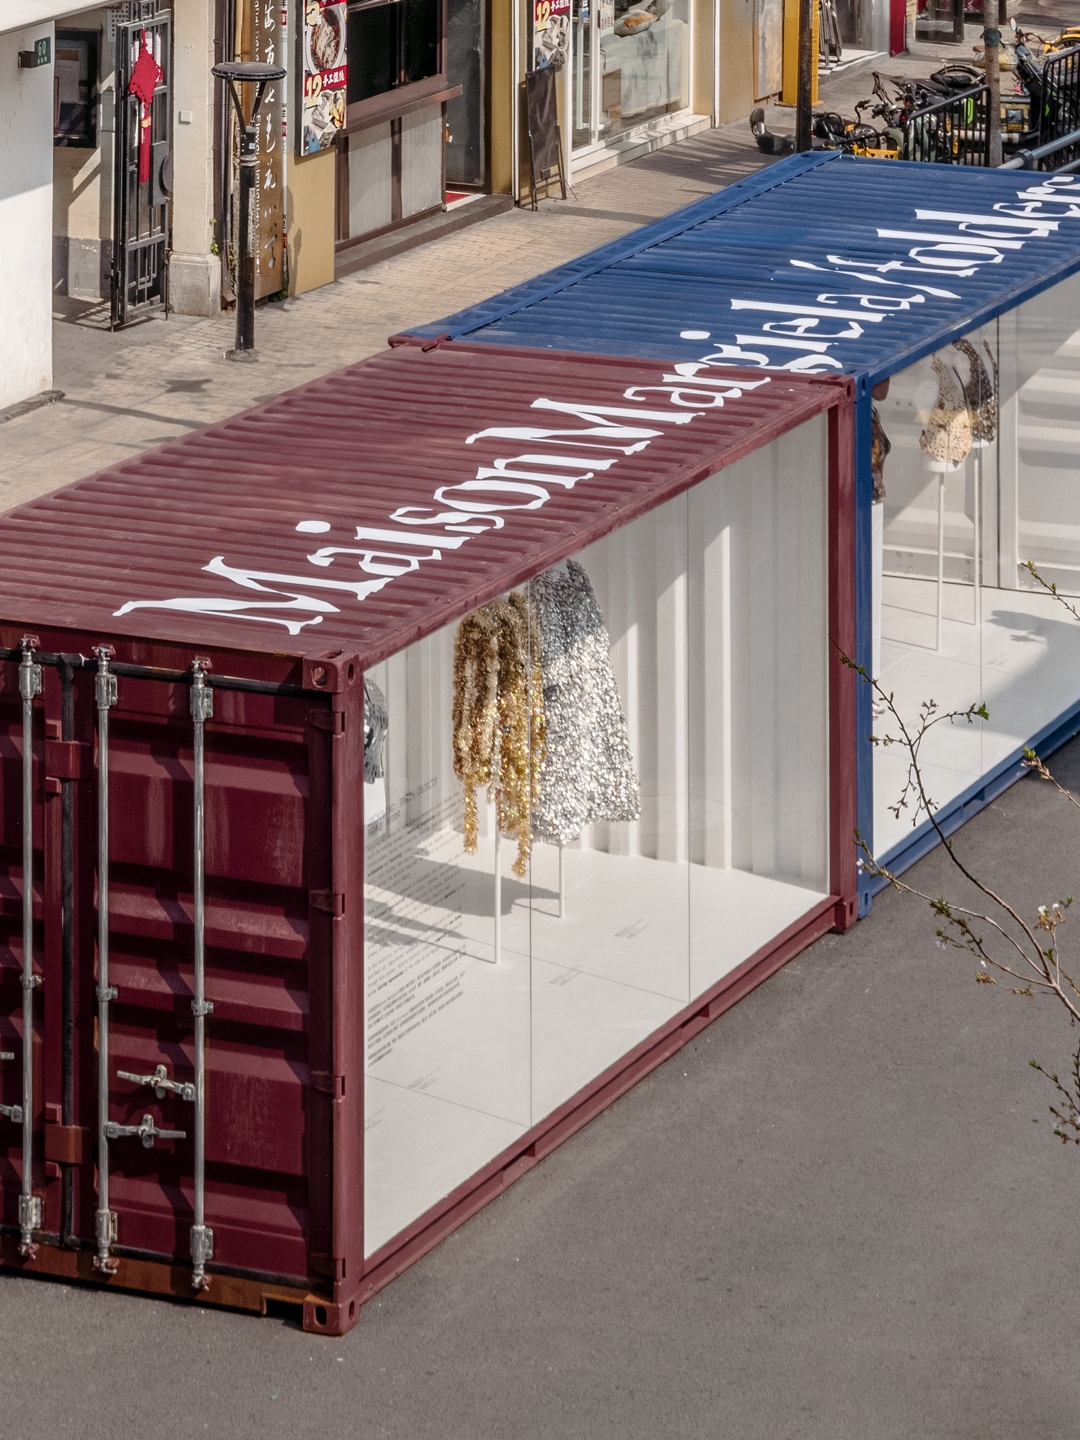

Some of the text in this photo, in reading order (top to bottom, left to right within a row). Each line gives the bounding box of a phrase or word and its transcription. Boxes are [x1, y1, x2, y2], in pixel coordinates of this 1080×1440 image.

[536, 1, 550, 31] 12
[38, 40, 47, 56] 60
[305, 75, 323, 108] 12
